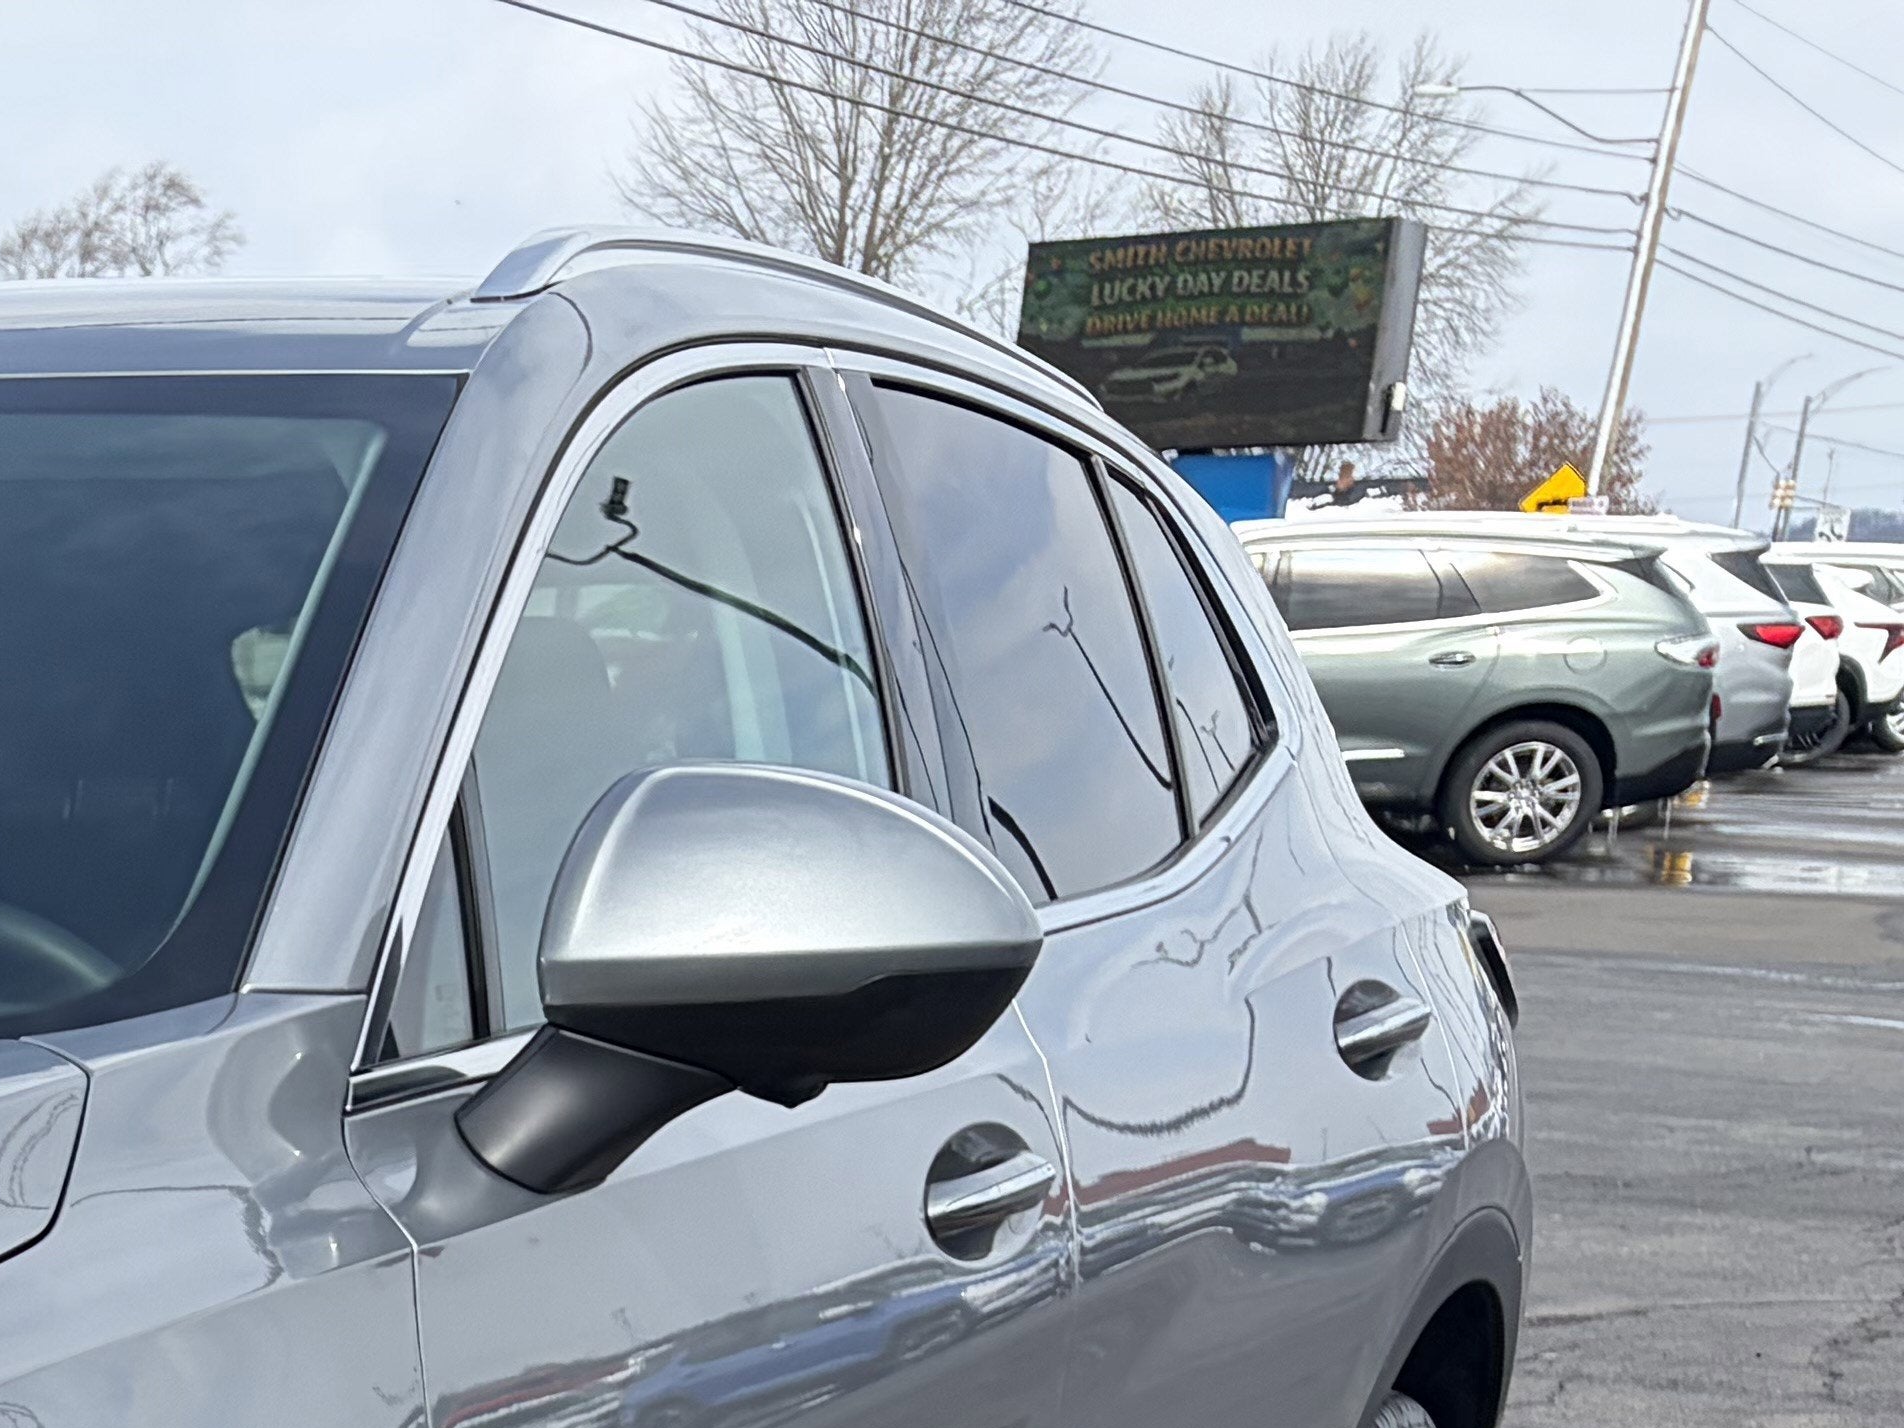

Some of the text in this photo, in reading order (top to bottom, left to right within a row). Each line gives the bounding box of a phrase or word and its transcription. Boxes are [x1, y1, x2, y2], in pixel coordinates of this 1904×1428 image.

[1090, 236, 1312, 272] SMITH CHEVROLET
[1092, 268, 1311, 307] LUCKY DAY DEALS
[1086, 308, 1152, 336] DRIVE
[1156, 305, 1221, 328] HOME
[1225, 305, 1240, 324] A
